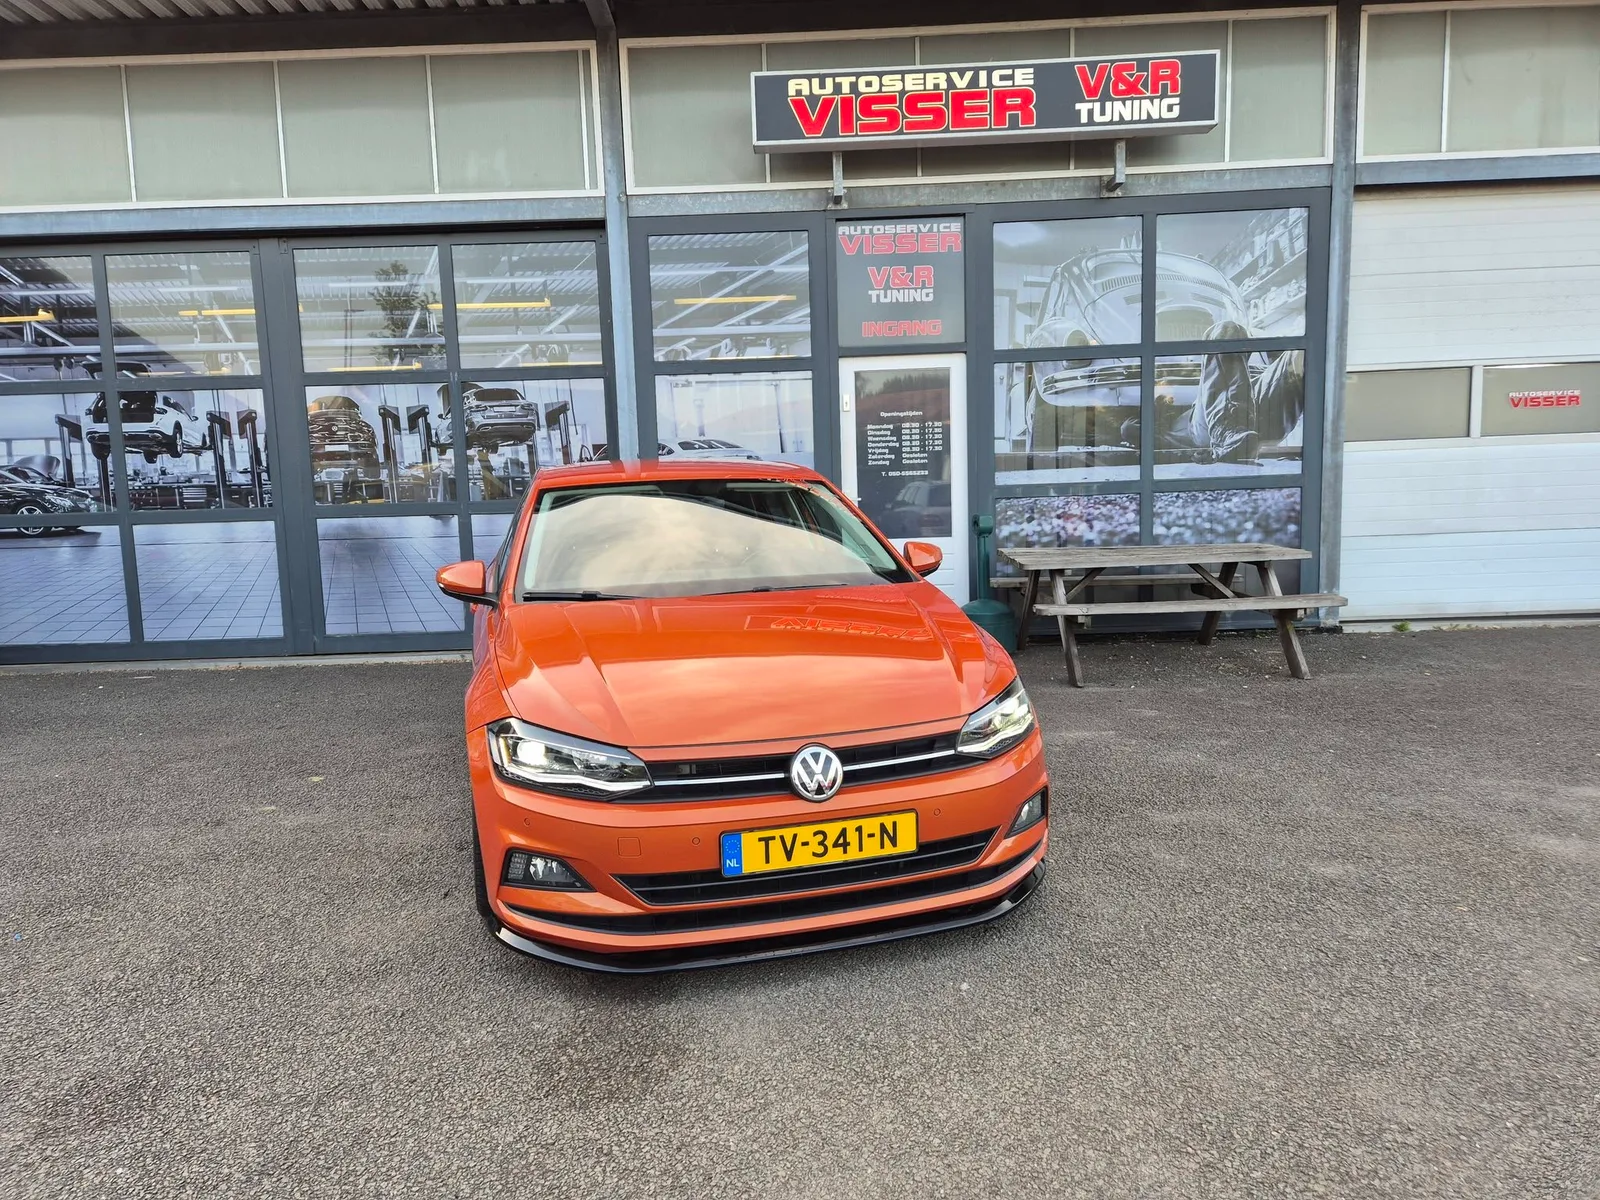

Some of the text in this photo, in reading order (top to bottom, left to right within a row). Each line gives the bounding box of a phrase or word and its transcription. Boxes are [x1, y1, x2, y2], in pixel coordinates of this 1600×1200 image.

[787, 67, 1034, 96] AUTOSERVICE
[1074, 58, 1182, 100] V&R
[788, 87, 1036, 137] VISSER
[1075, 97, 1181, 124] TUNING
[838, 222, 961, 235] AUTOSERVICE
[838, 231, 962, 255] VISSER
[868, 265, 934, 289] V&R
[868, 288, 934, 303] TUNING
[862, 319, 942, 338] INGANG
[1508, 389, 1581, 397] AUTOSERVICE
[1509, 395, 1582, 409] VISSER
[757, 820, 898, 865] TV-341-N
[726, 859, 740, 868] NL
